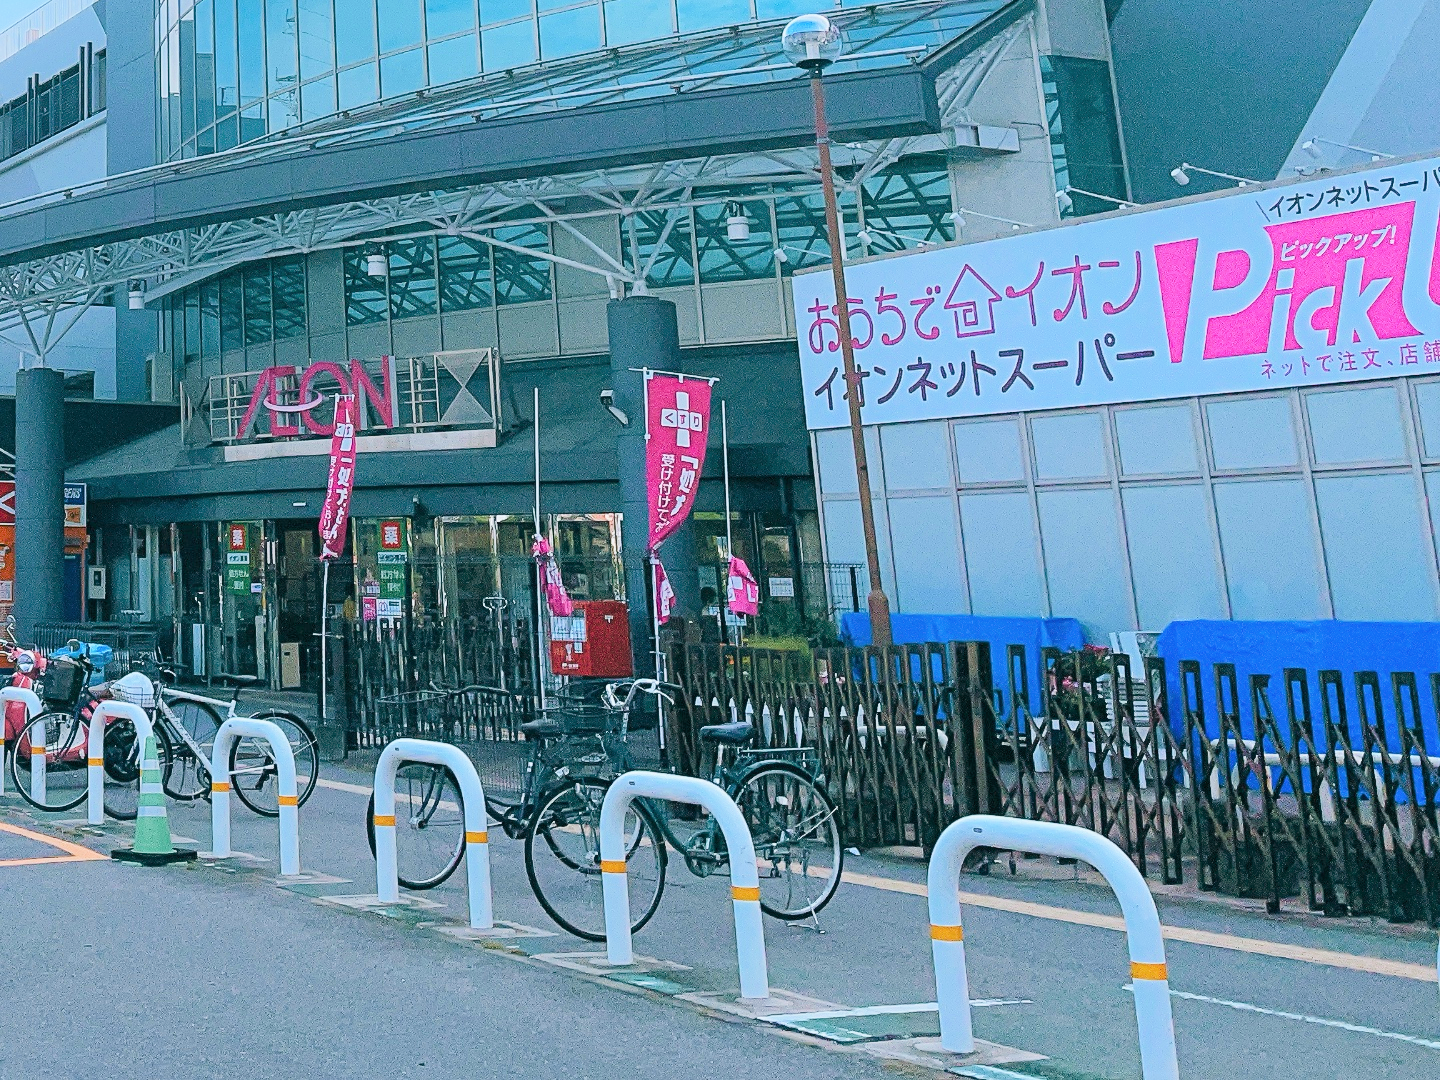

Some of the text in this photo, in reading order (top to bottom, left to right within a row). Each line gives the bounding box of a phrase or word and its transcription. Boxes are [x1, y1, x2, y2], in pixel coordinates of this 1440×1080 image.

[236, 354, 396, 439] AEON
[814, 333, 1155, 411] イオンネットスーパー
